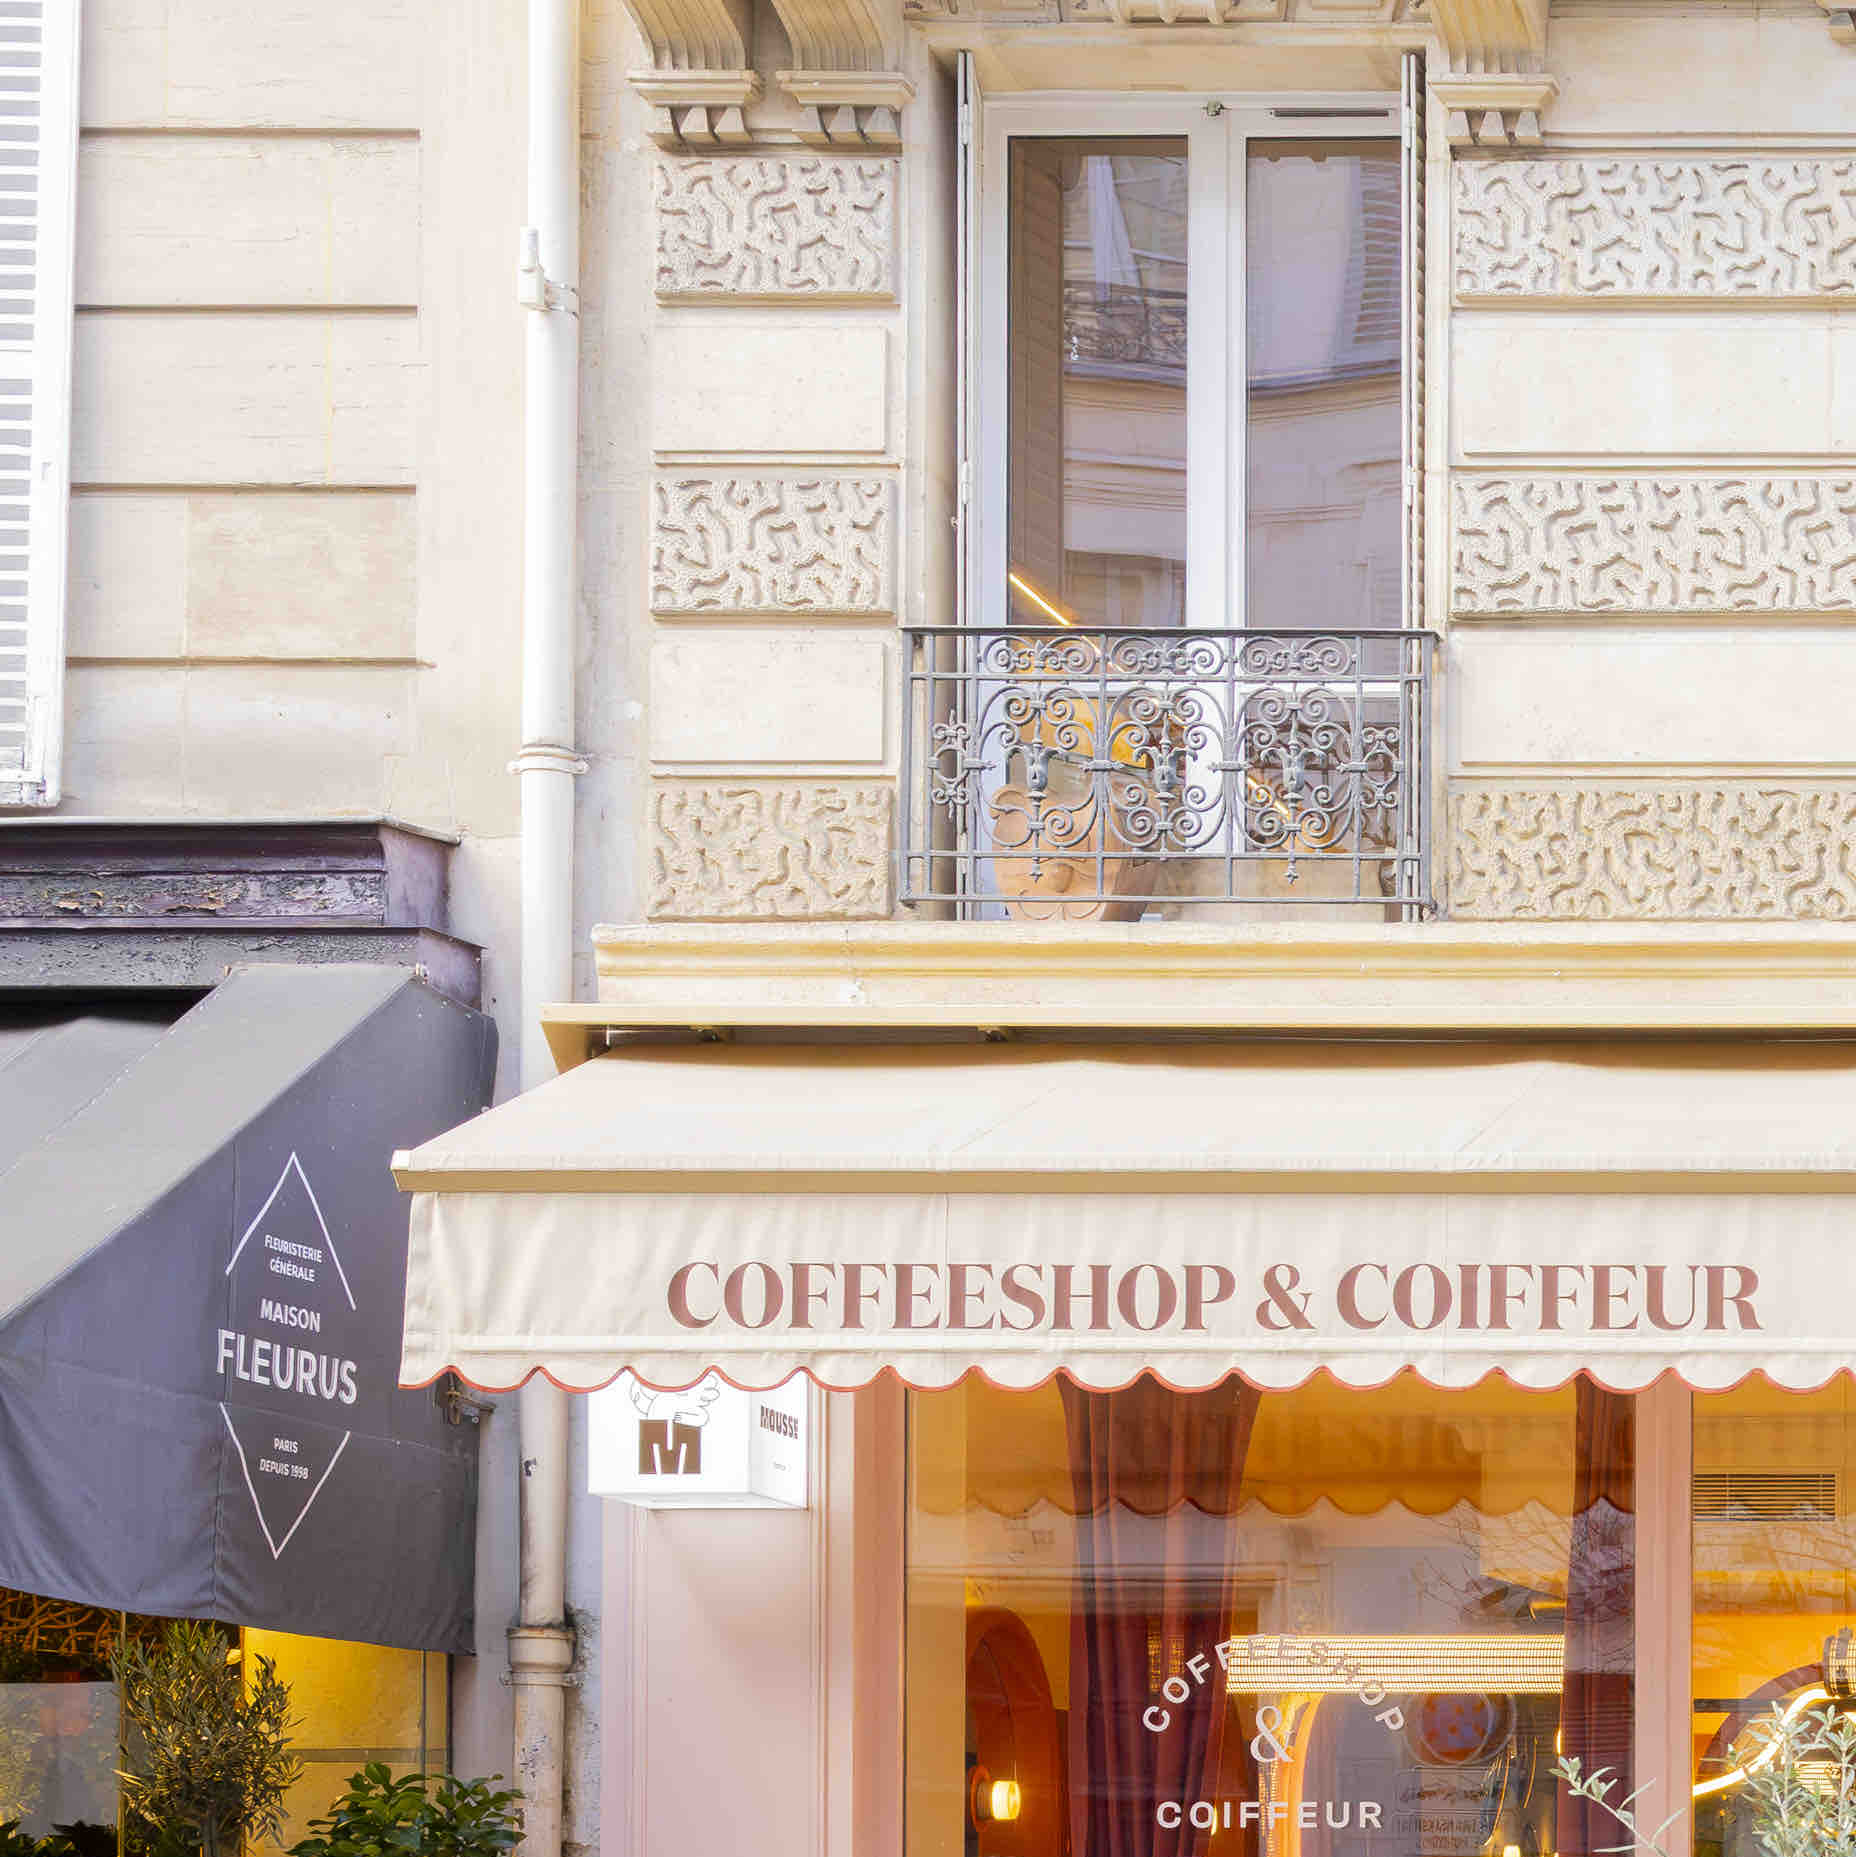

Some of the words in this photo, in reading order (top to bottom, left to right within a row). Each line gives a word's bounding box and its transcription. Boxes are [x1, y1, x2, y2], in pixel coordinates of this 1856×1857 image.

[264, 1234, 322, 1263] FLEURISTERIE
[270, 1257, 315, 1282] GÉNÉRALE
[667, 1262, 1236, 1331] COFFEESHOP
[1256, 1263, 1318, 1331] &
[1336, 1263, 1764, 1331] COIFFEUR
[260, 1298, 321, 1333] MAISON
[216, 1328, 357, 1405] FLEURUS
[273, 1438, 299, 1454] PARIS
[638, 1419, 702, 1475] M
[260, 1458, 289, 1476] DEPUIS
[1142, 1633, 1404, 1732] COFFEESHOP
[1250, 1705, 1295, 1763] &
[1156, 1801, 1383, 1829] COIFFEUR
